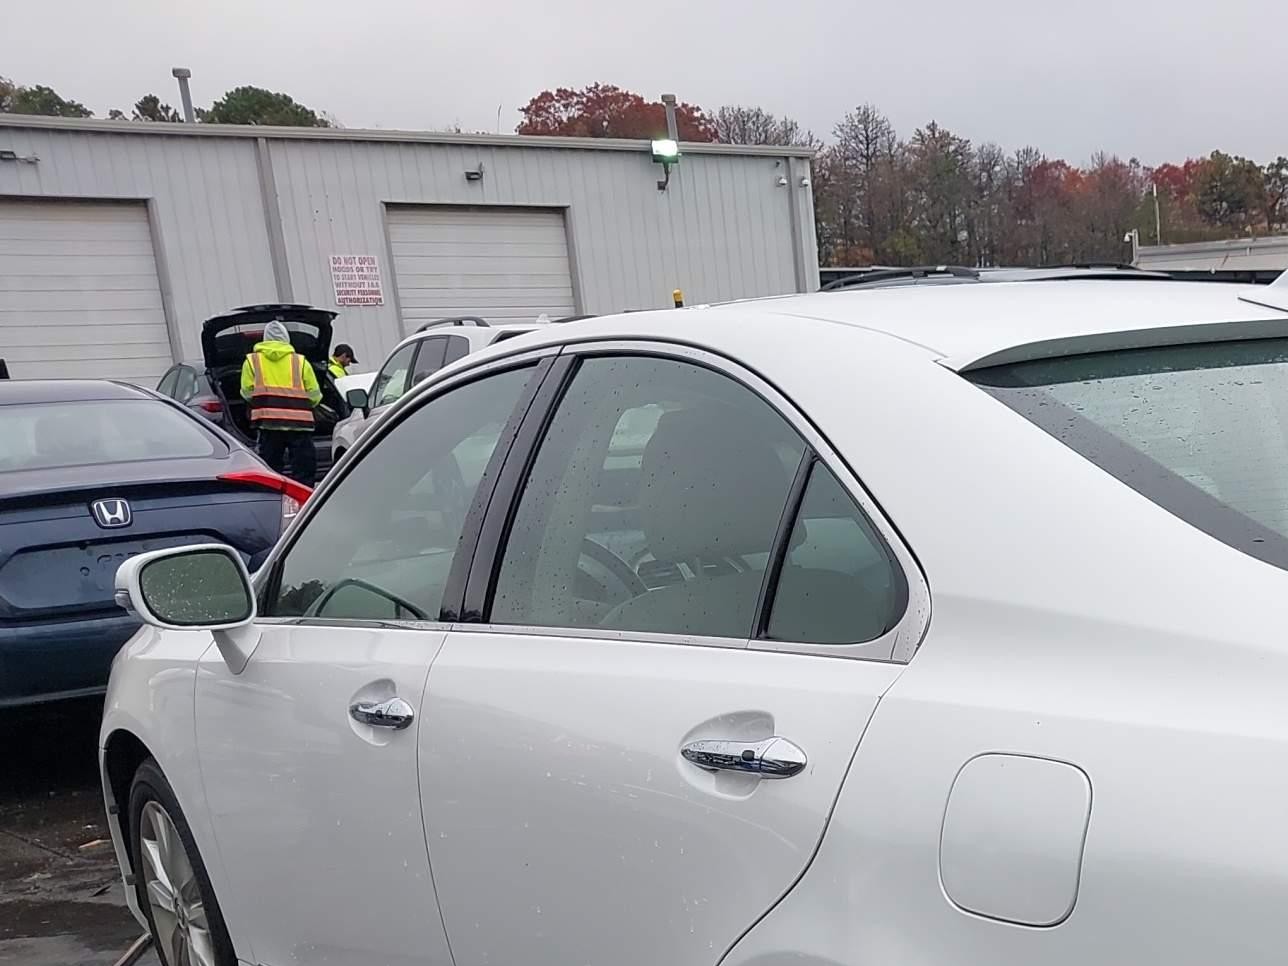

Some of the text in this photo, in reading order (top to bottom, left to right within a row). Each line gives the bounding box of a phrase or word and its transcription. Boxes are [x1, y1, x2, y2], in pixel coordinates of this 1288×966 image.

[332, 256, 376, 265] DO NOT OPEN
[335, 281, 366, 289] WITHOUT
